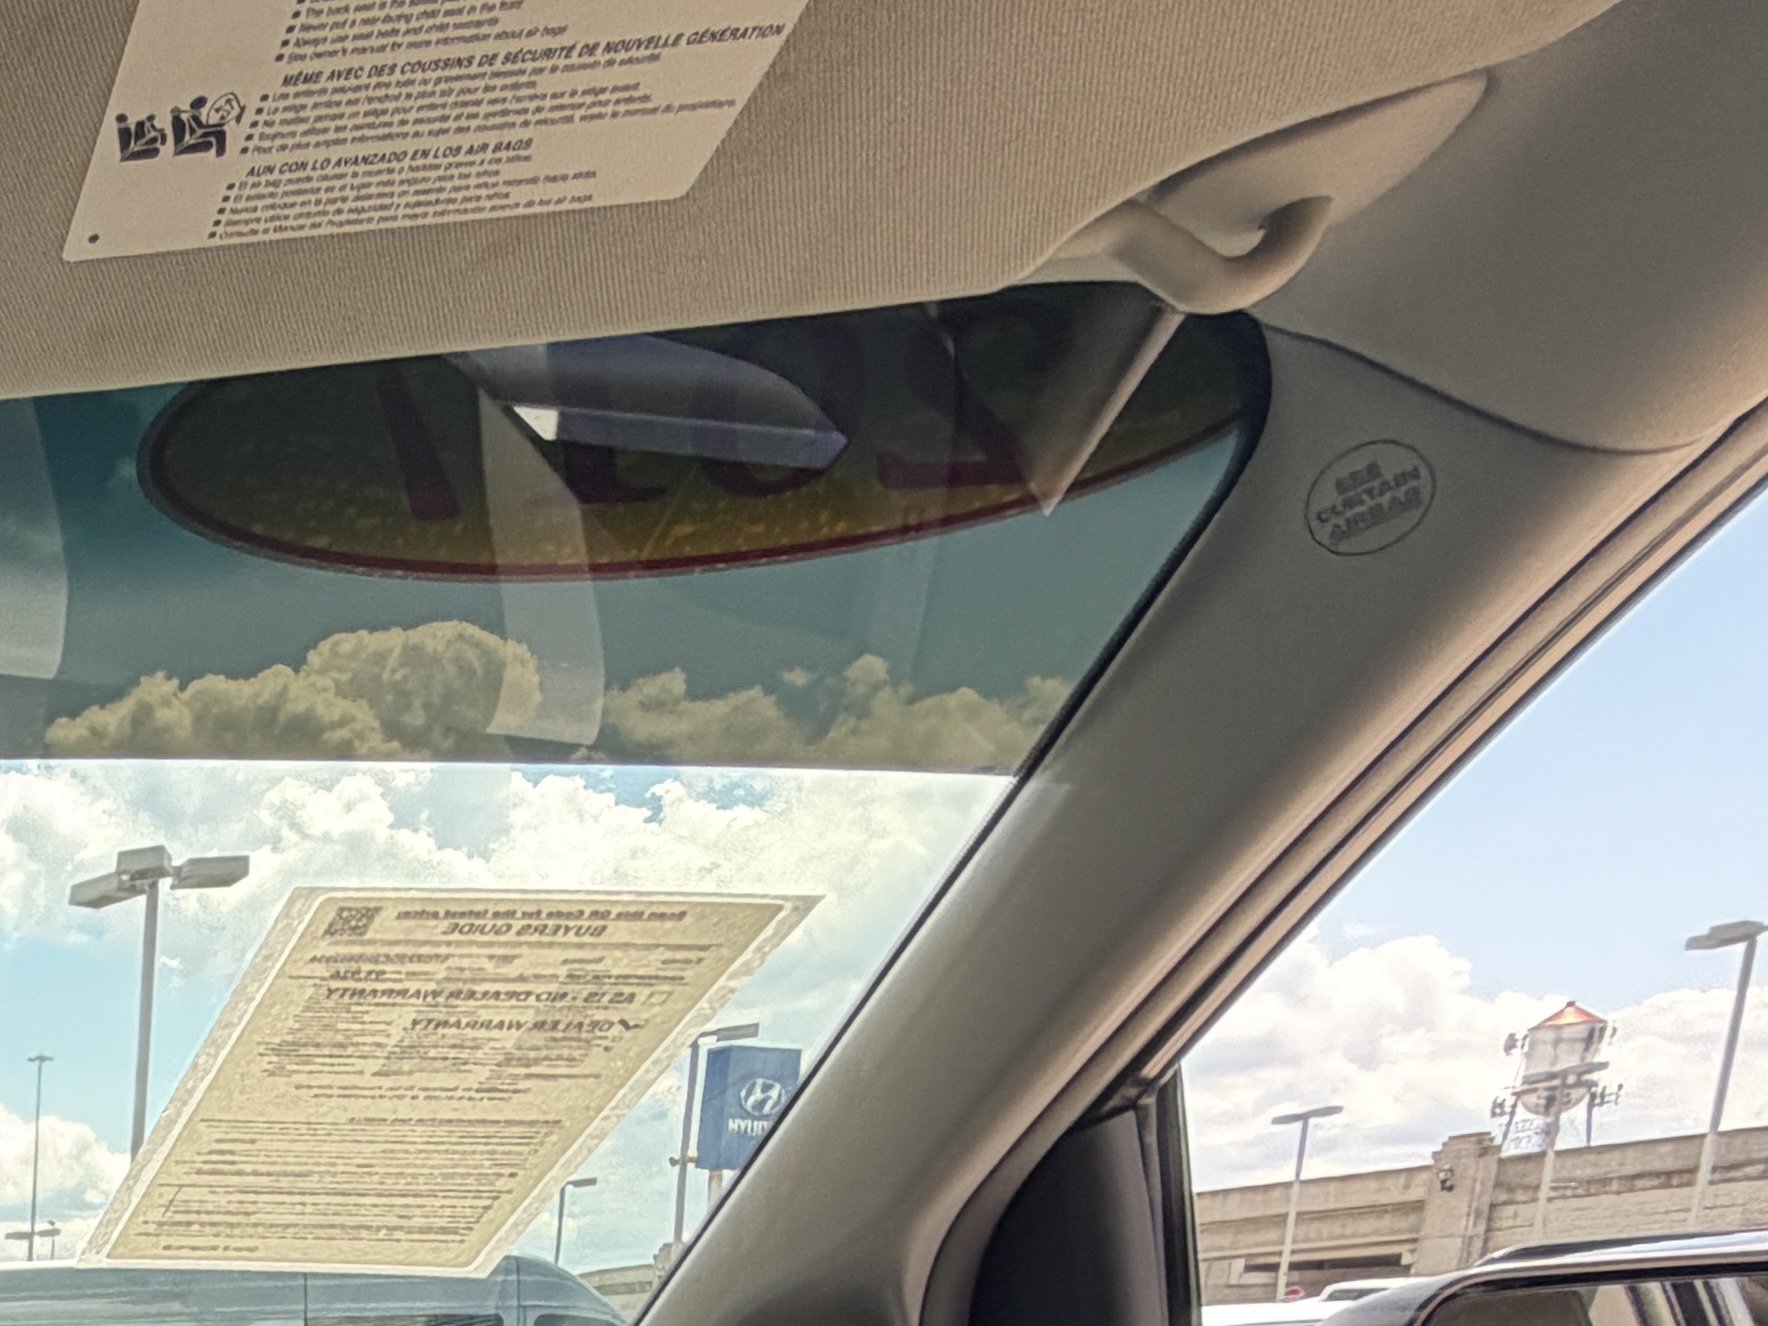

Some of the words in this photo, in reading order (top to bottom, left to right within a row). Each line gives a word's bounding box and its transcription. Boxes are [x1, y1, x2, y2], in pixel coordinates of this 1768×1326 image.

[325, 65, 365, 82] AVEC
[367, 62, 397, 79] DES
[400, 55, 475, 76] COUSSINS
[477, 52, 500, 67] DE
[501, 40, 578, 66] SÉCURITÉ
[577, 41, 601, 58] DE
[602, 33, 685, 54] NOUVELLE
[686, 22, 787, 46] GÉNÉRATION
[278, 161, 308, 175] CON
[311, 158, 332, 172] LO
[332, 151, 408, 169] AVANZADO
[409, 149, 430, 162] EN
[432, 145, 461, 159] LOS
[464, 142, 489, 156] AIR
[491, 137, 534, 153] BAGS
